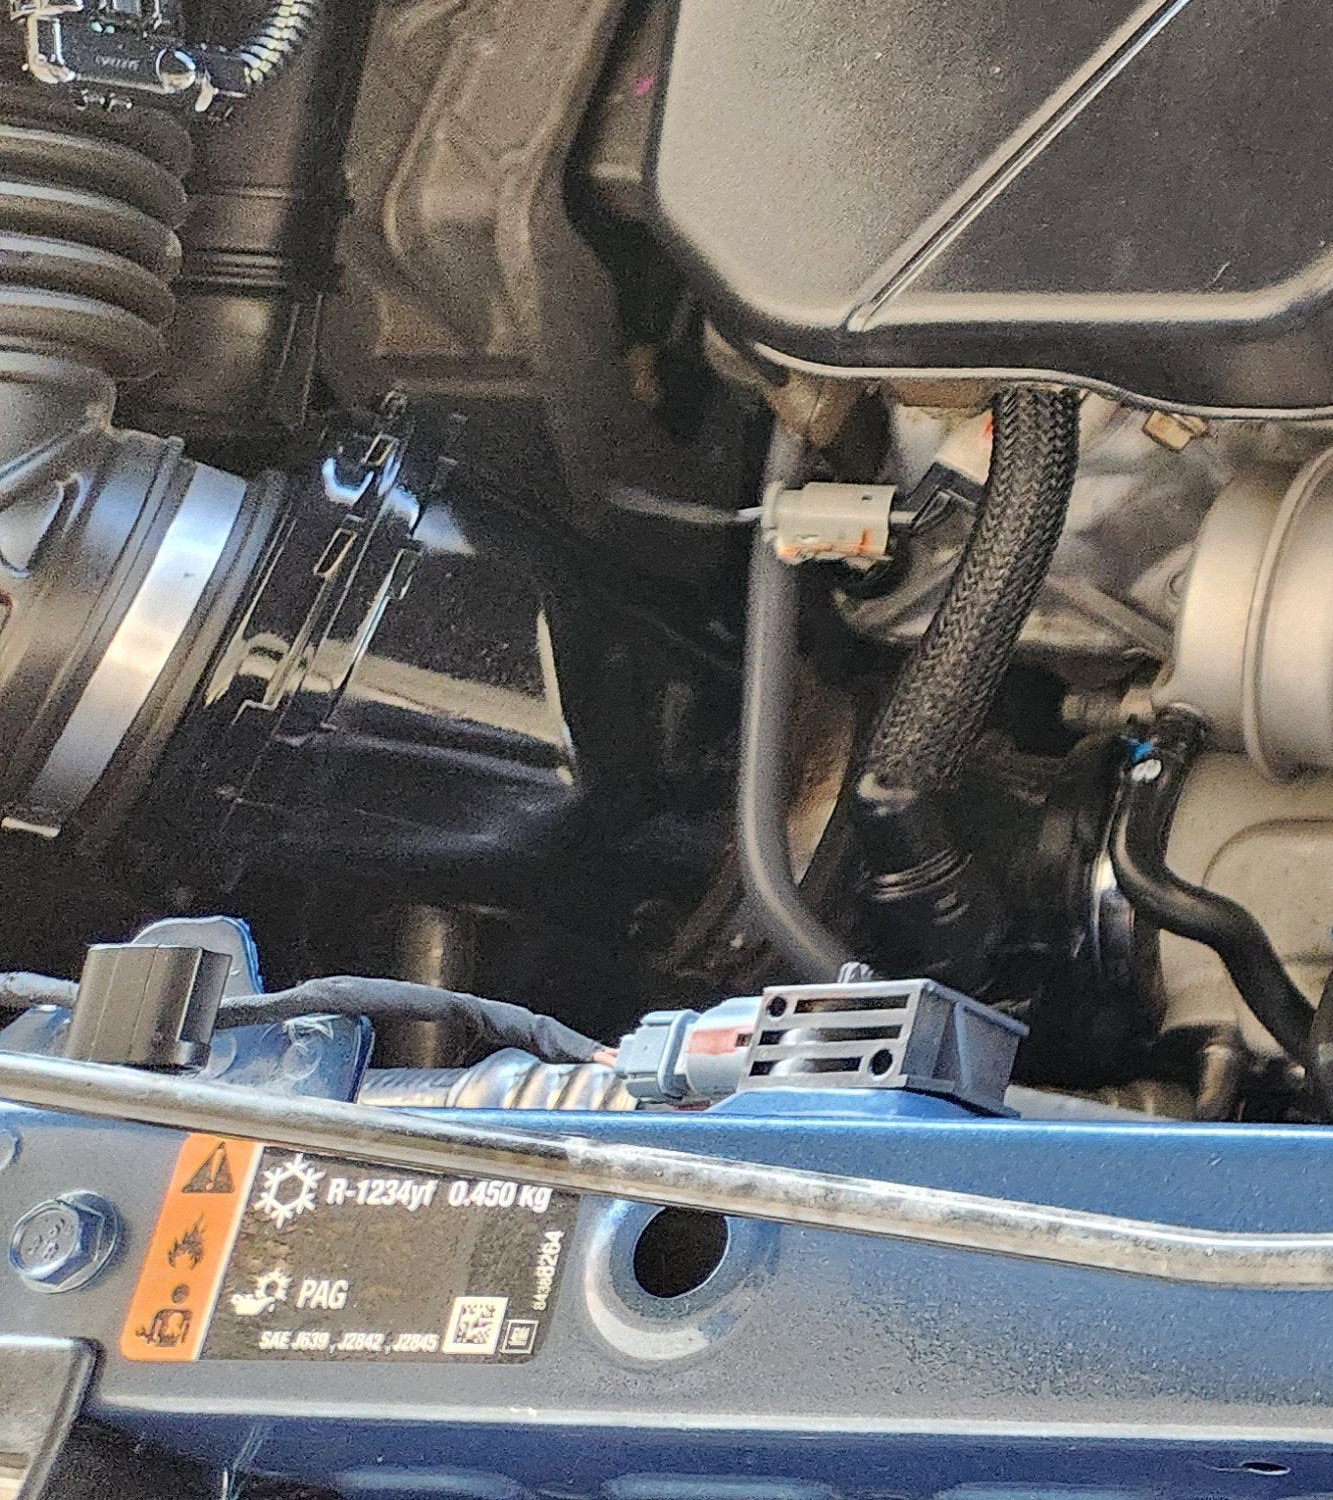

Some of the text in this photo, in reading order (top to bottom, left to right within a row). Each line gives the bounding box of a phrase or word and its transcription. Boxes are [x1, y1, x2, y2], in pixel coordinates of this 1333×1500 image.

[326, 1178, 440, 1212] R-1234yf
[449, 1180, 518, 1208] 0.450
[296, 1279, 349, 1310] PAG
[258, 1331, 292, 1350] SAE
[393, 1333, 441, 1353] J2845
